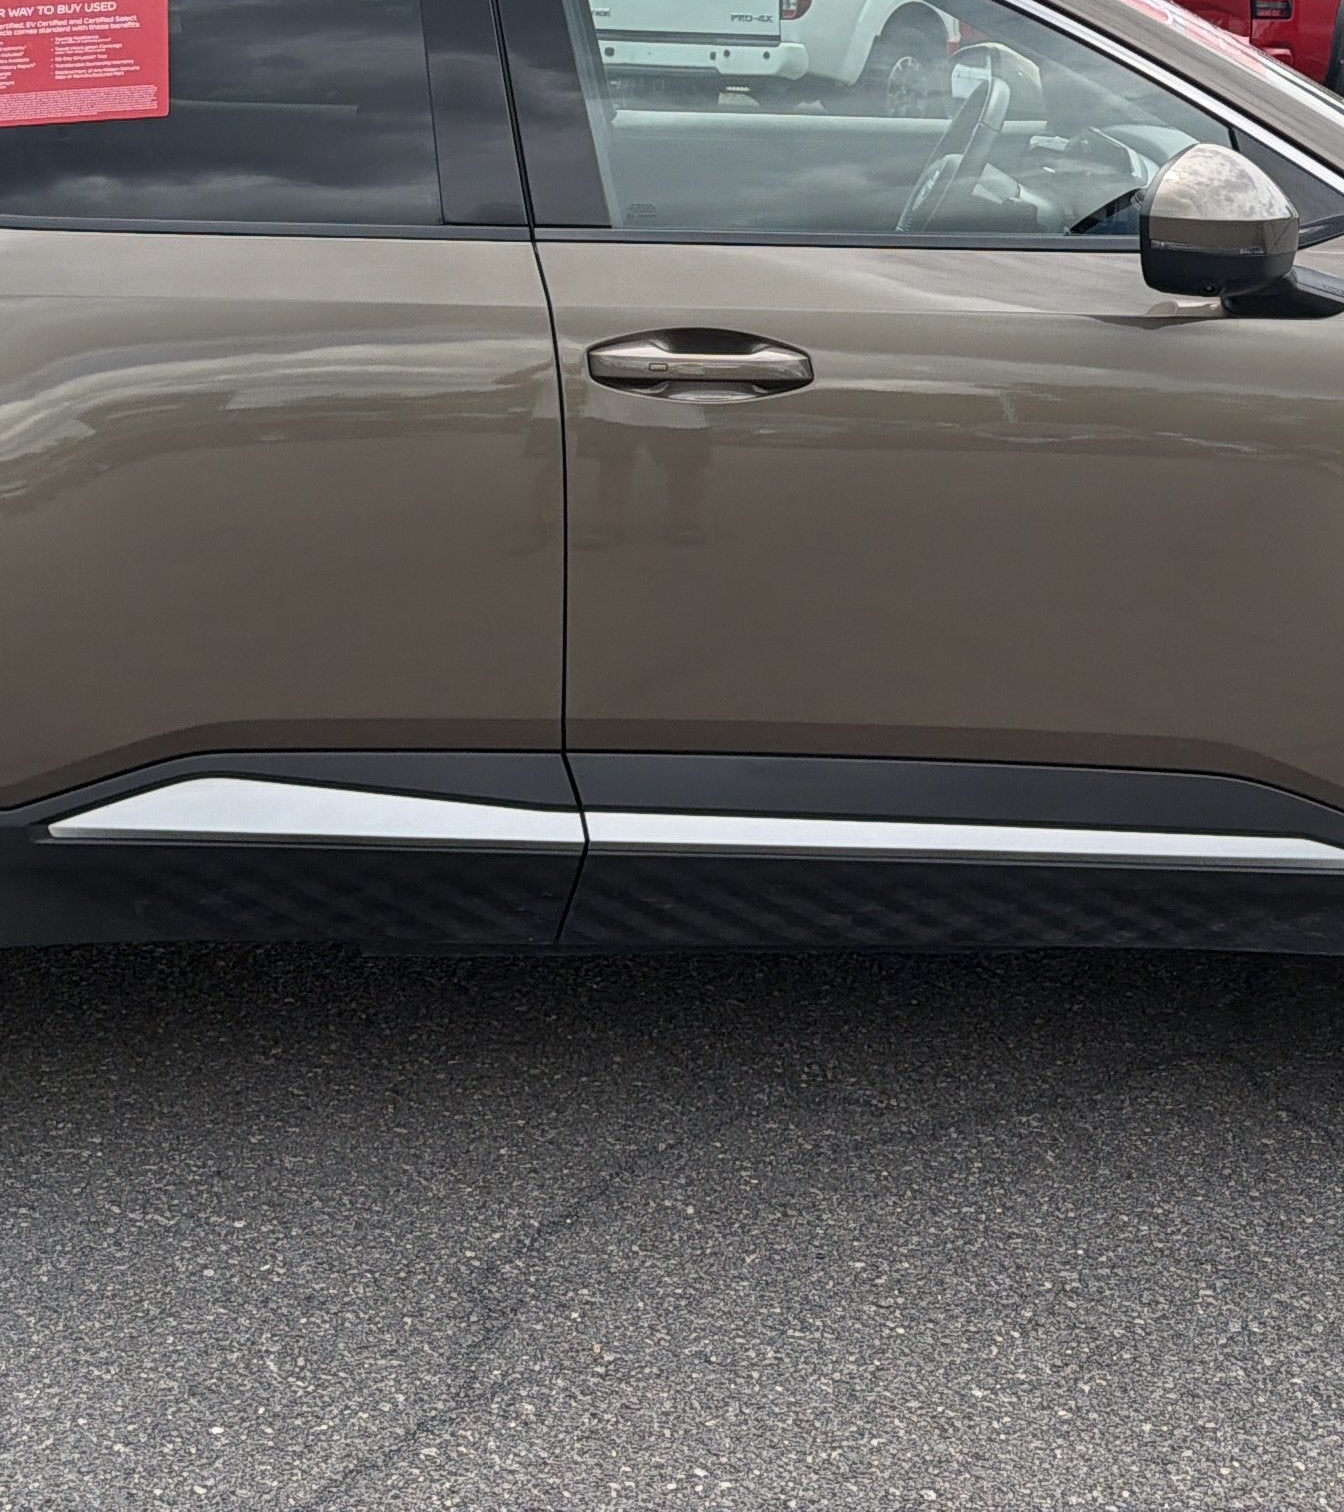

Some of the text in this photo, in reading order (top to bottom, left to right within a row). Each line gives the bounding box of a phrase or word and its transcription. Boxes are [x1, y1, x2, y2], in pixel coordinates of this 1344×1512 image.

[8, 6, 34, 18] WAY
[37, 5, 55, 15] TO
[56, 3, 83, 14] BUY
[84, 1, 117, 12] USED
